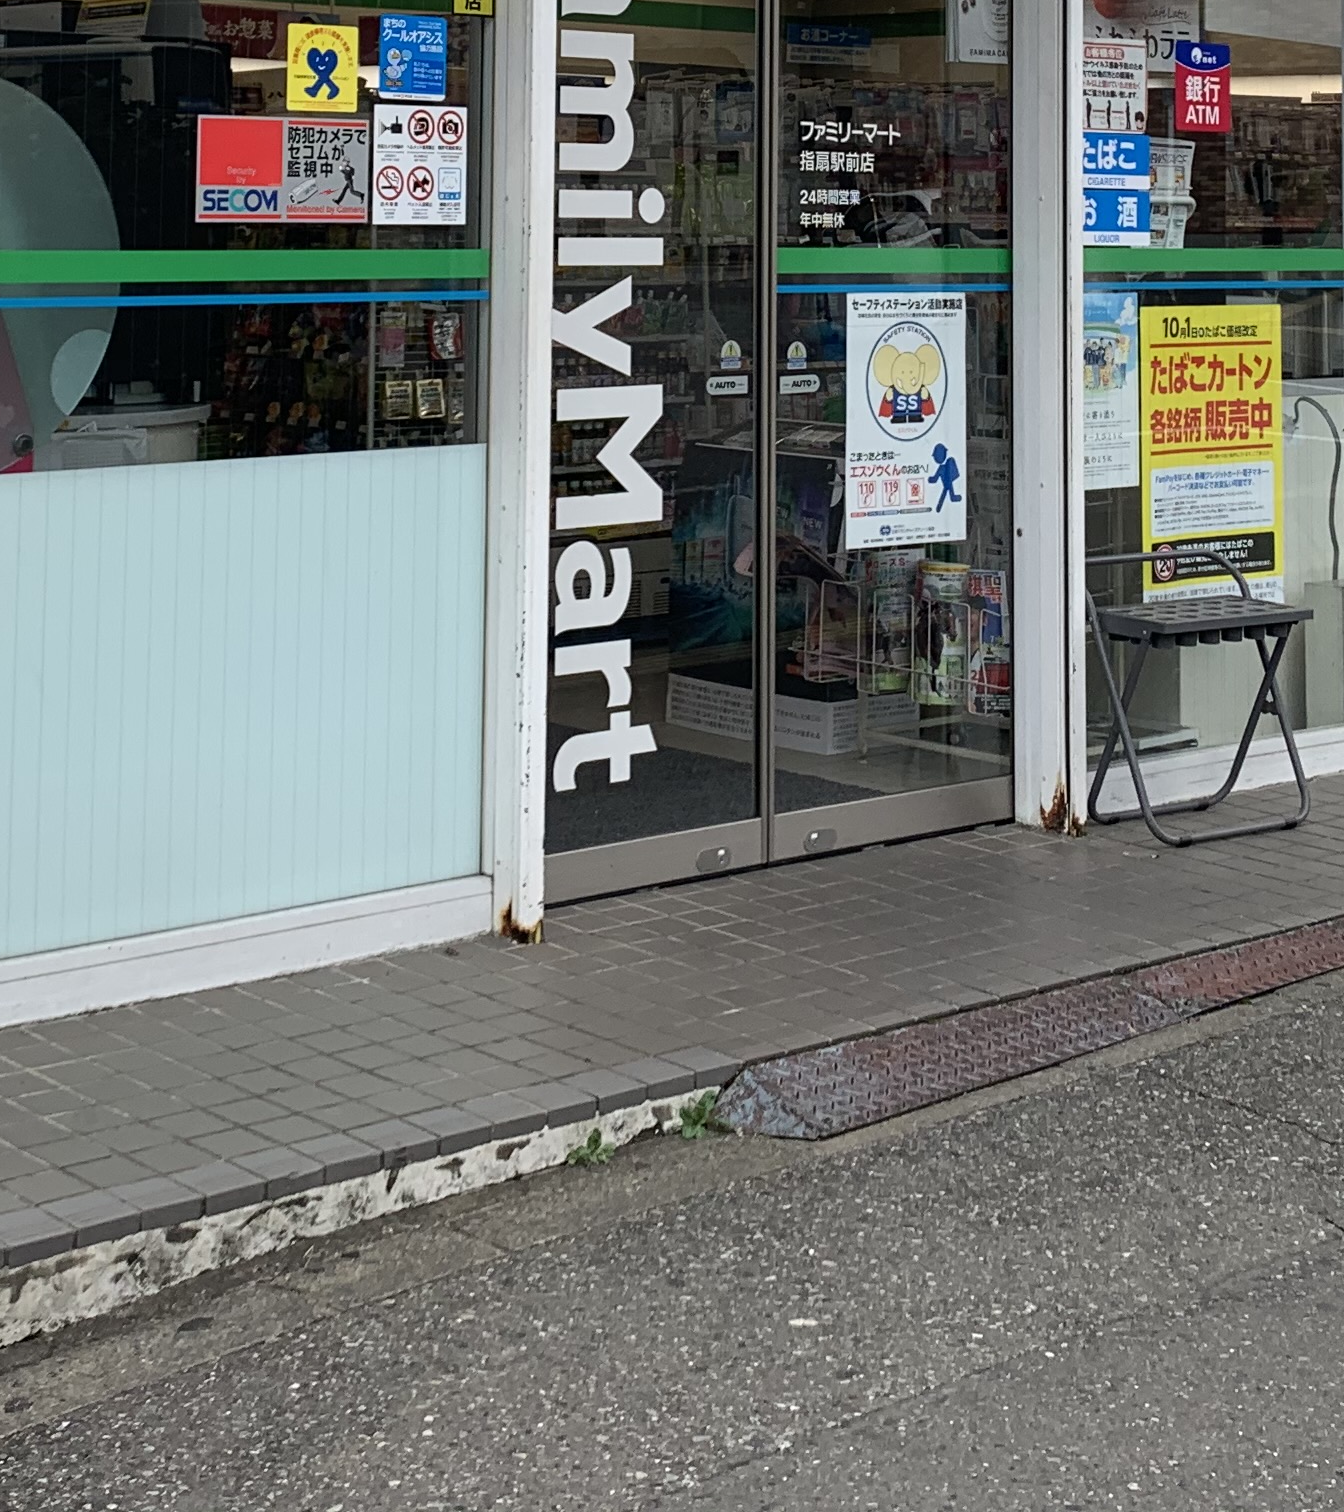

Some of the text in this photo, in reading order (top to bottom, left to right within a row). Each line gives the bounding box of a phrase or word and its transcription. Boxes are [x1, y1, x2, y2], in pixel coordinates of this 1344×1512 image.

[383, 18, 406, 28] まちの
[383, 28, 443, 44] クールオアシス
[1185, 75, 1221, 103] 銀行
[1185, 104, 1220, 125] ATM
[288, 126, 367, 145] 防犯カメラで
[800, 120, 902, 146] ファミリーマート
[288, 144, 344, 161] セコムが
[287, 161, 333, 178] 監視中
[799, 151, 875, 173] 指扇駅前店
[227, 166, 256, 176] Security
[1087, 177, 1126, 187] CIGARETTE
[203, 189, 278, 212] SECOM
[799, 190, 861, 206] 24時間営業
[799, 213, 845, 229] 年中無休
[1094, 234, 1120, 244] LIQUOR
[852, 298, 963, 311] セーフティステーション活動実施店
[883, 326, 932, 344] SAFETY STATION
[1150, 352, 1272, 395] たばこカートン
[715, 380, 735, 389] AUTO
[792, 379, 812, 388] AUTO
[896, 395, 918, 411] SS
[859, 482, 874, 495] 110
[884, 481, 898, 493] 119
